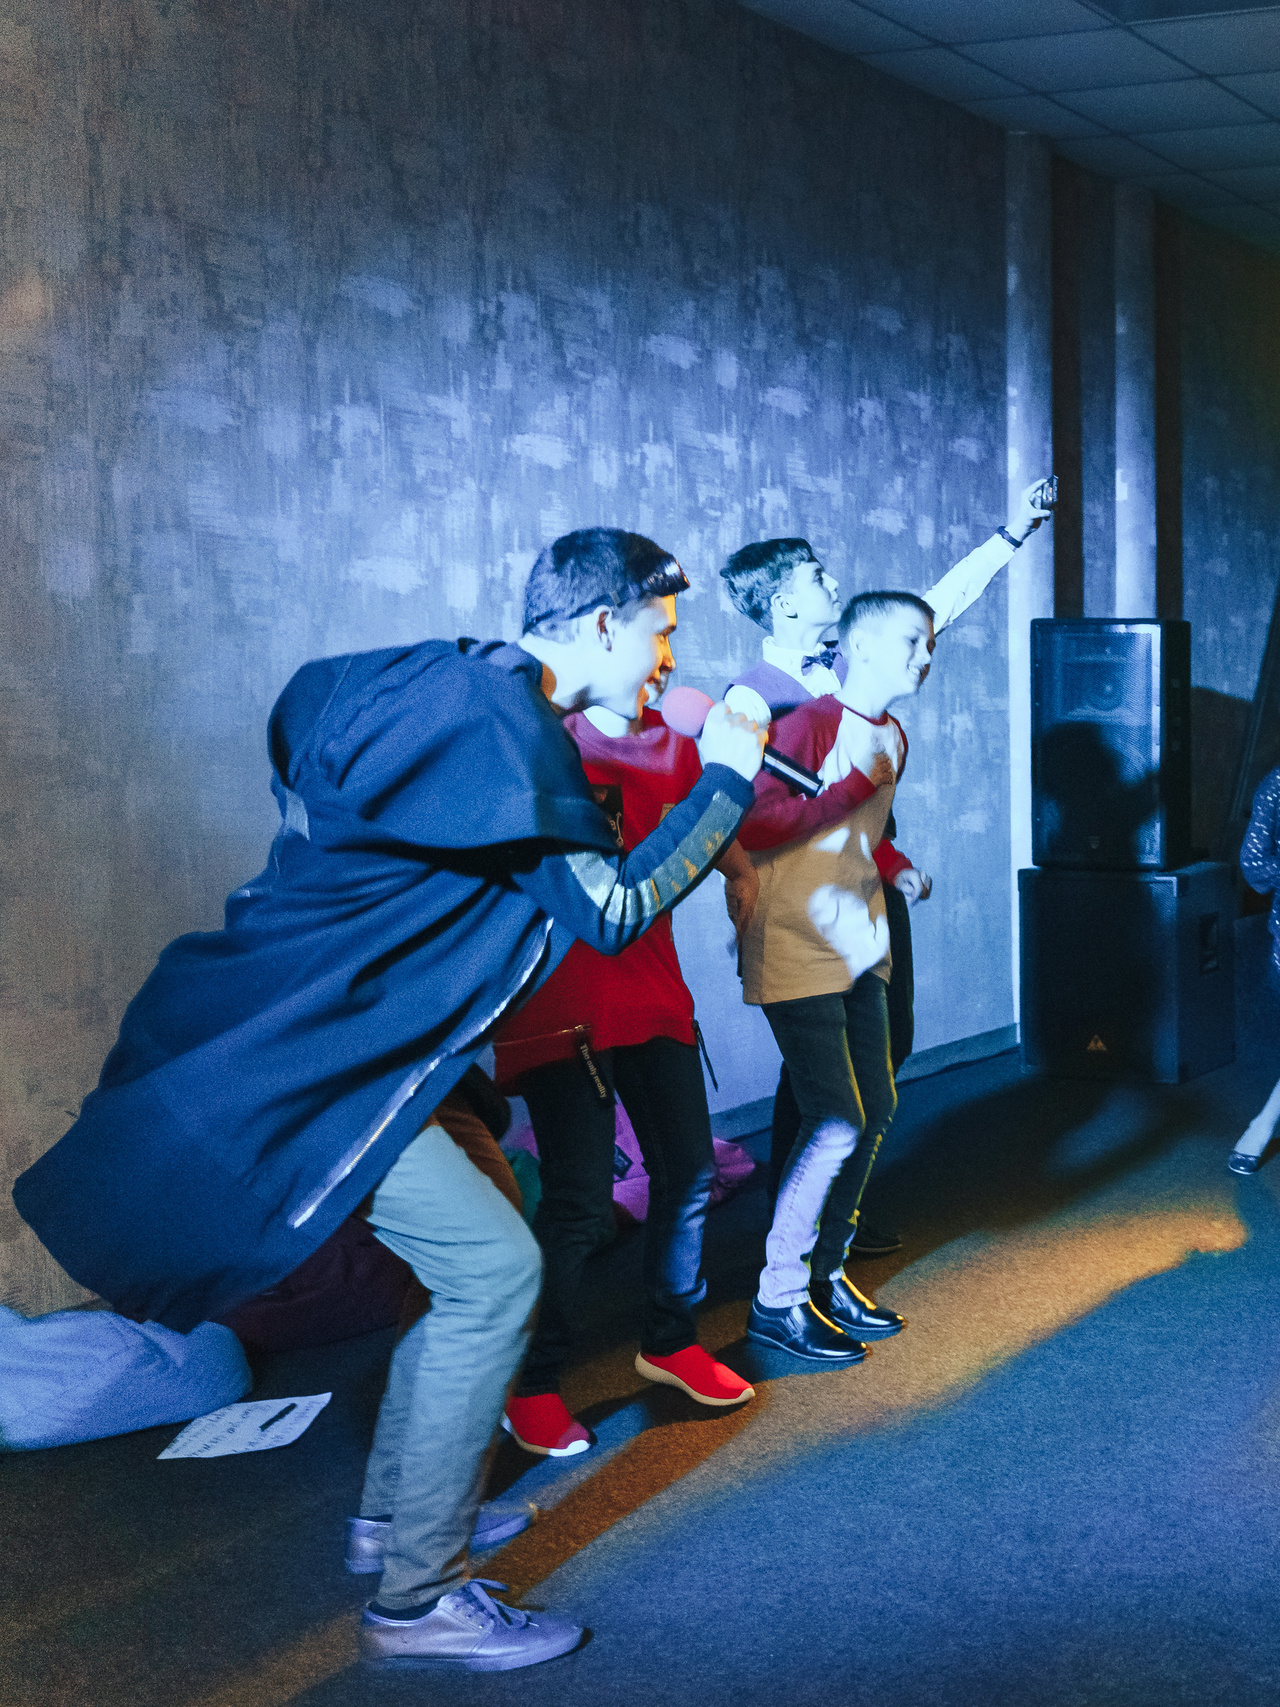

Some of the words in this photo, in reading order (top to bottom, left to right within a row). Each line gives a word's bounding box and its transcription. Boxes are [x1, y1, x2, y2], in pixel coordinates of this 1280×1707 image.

[580, 1043, 590, 1060] The
[587, 1060, 597, 1075] only
[594, 1075, 607, 1098] reality
